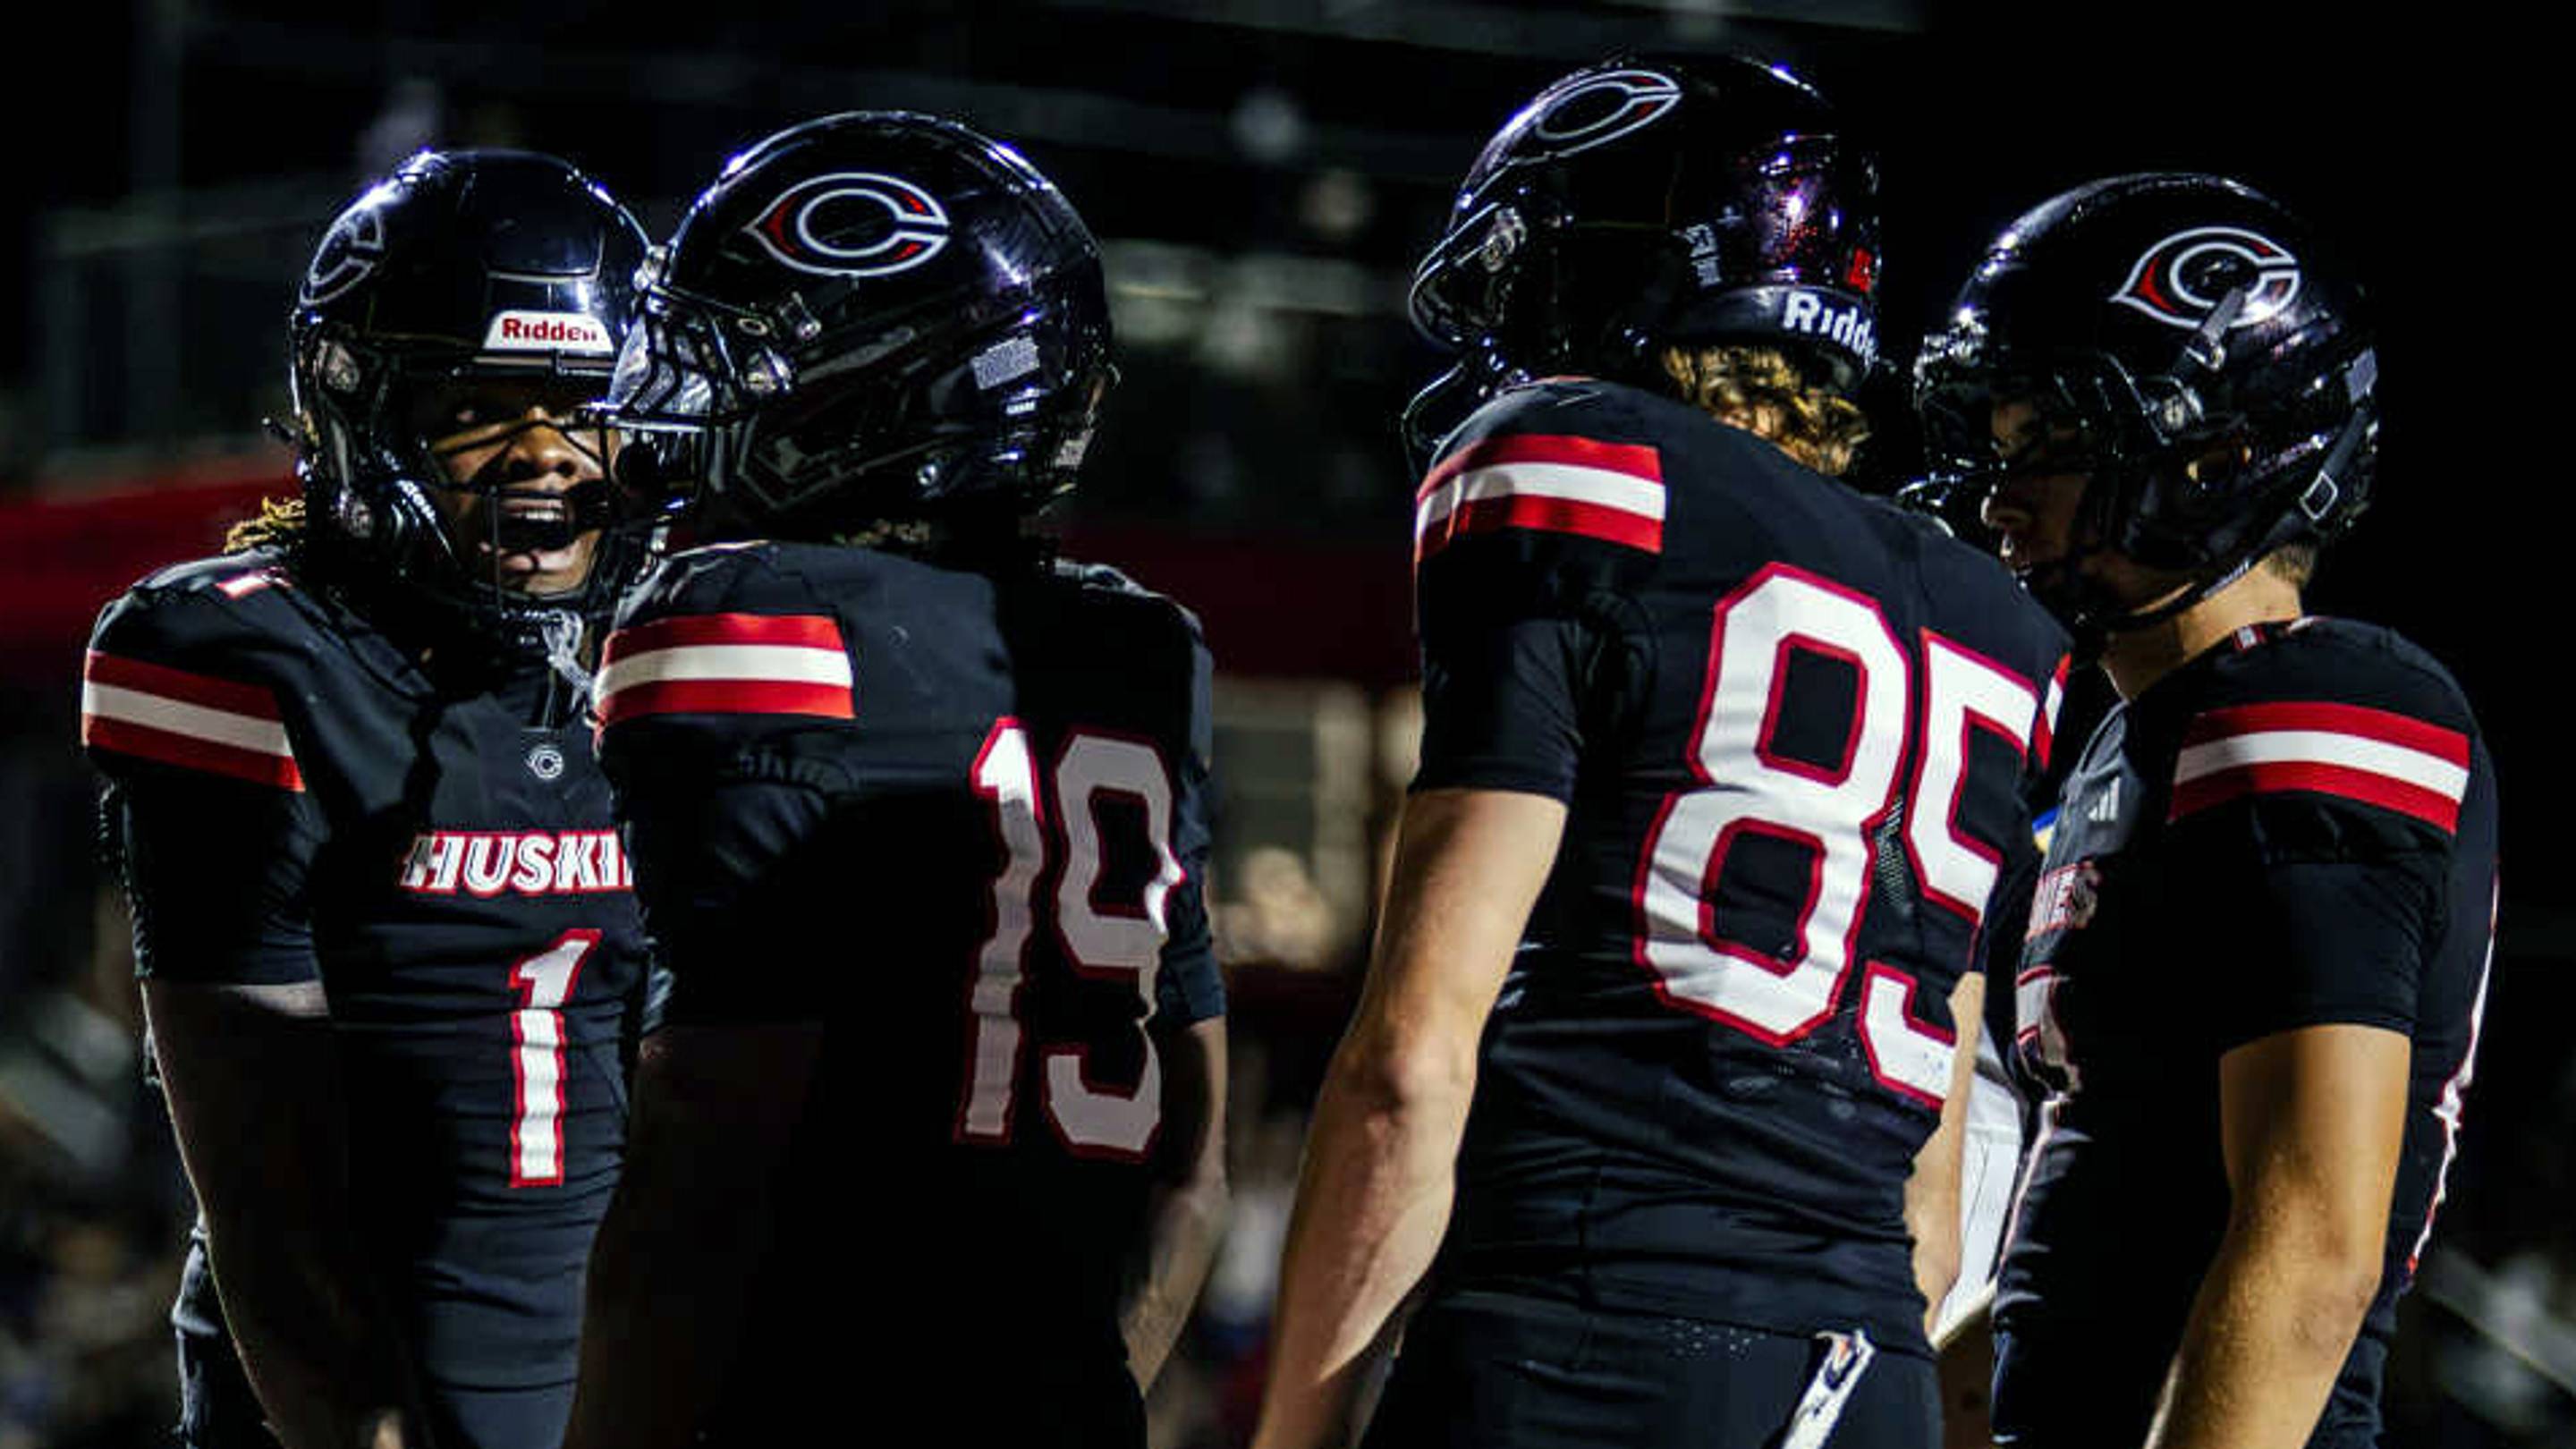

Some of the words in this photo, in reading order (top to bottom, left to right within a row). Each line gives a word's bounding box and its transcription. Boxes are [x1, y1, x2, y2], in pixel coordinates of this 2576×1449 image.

[741, 173, 950, 276] C
[1783, 290, 1878, 369] Ridd
[400, 827, 633, 897] HUSKI
[1633, 560, 2046, 1109] 85
[953, 716, 1186, 1161] 19
[509, 928, 603, 1188] 1
